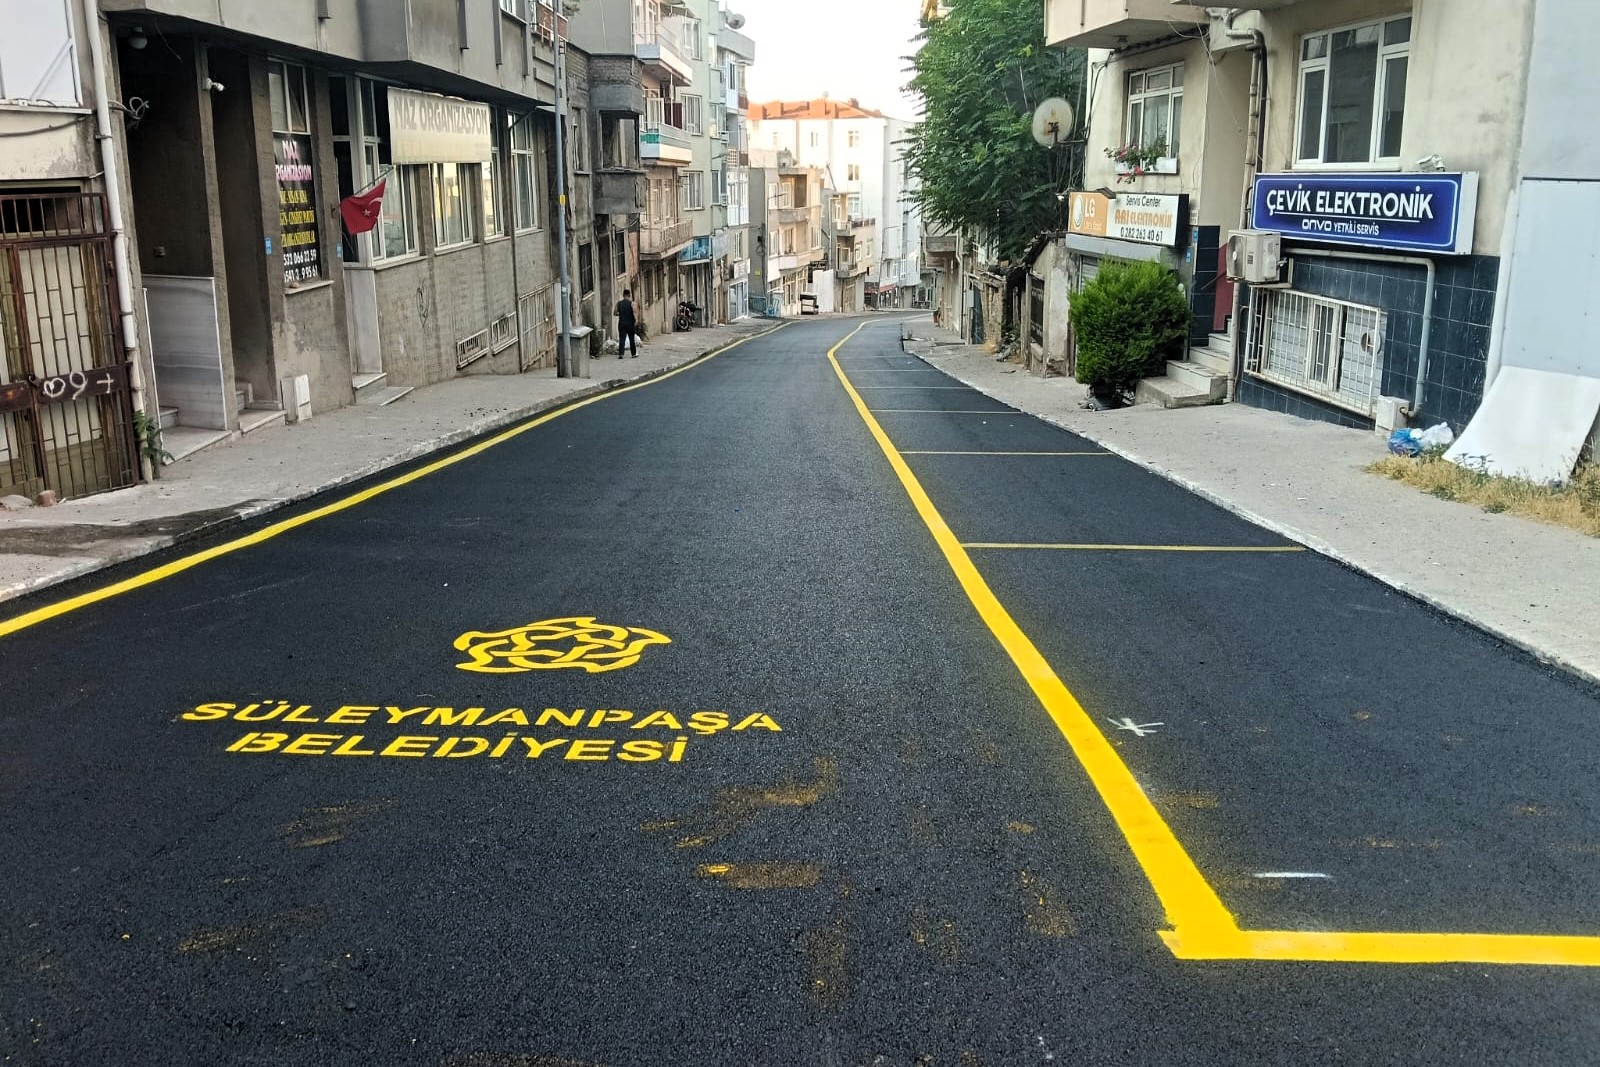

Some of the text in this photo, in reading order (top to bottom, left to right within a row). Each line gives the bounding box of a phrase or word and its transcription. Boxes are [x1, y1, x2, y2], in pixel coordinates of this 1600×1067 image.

[393, 96, 417, 131] NAZ
[1084, 197, 1096, 218] LG
[1126, 195, 1161, 208] Servis Center
[1266, 183, 1434, 219] ÇEVİK ELEKTRONİK
[1356, 222, 1380, 236] SERVİS
[181, 699, 783, 735] SÜLEYMANPAŞA
[225, 732, 689, 763] BELEDİYESİ
